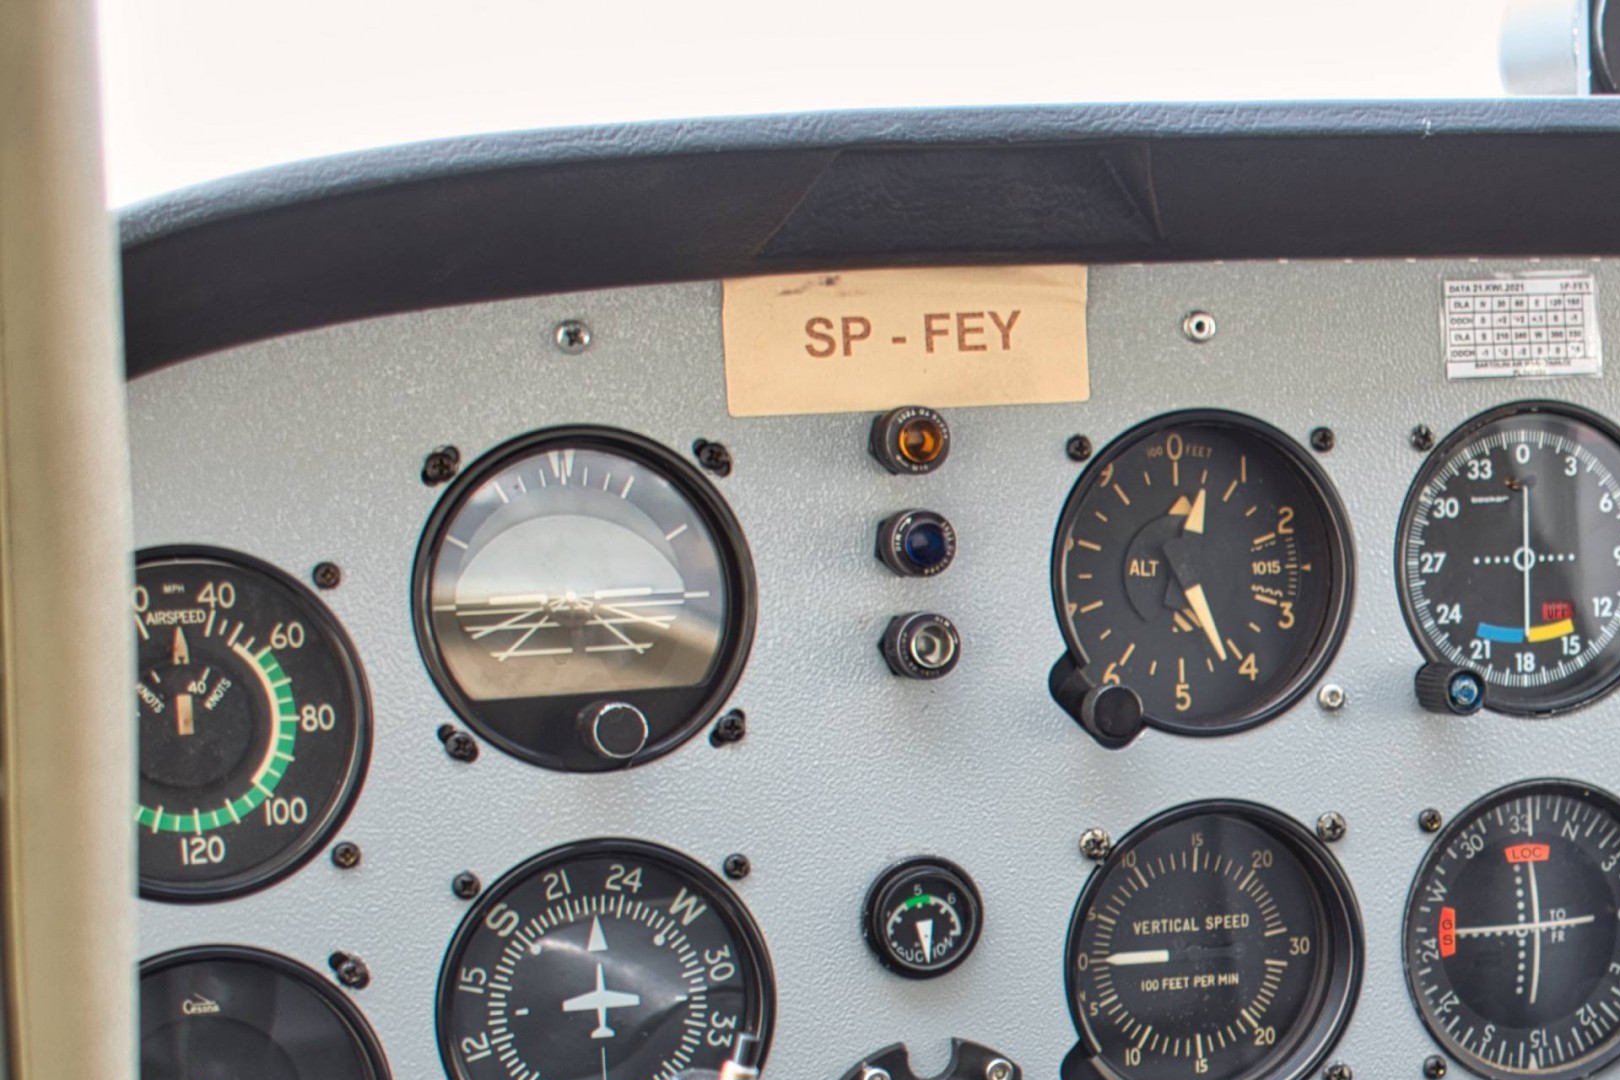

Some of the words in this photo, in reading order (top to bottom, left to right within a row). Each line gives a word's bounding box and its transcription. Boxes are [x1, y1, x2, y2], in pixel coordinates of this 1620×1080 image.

[804, 315, 872, 359] SP
[923, 309, 1021, 355] FEY
[1166, 433, 1184, 460] 0
[1515, 444, 1531, 464] 0
[1466, 458, 1494, 480] 33
[1564, 456, 1578, 476] 3
[1432, 497, 1460, 518] 30
[1277, 506, 1295, 534] 2
[1128, 559, 1160, 578] ALT
[1251, 561, 1281, 575] 1015
[1419, 551, 1447, 574] 27
[162, 583, 185, 594] MPH
[197, 581, 236, 609] 40
[145, 609, 207, 626] AIRSPEED
[1278, 601, 1296, 629] 3
[1436, 603, 1463, 625] 24
[1593, 597, 1613, 617] 12
[270, 621, 305, 650] 60
[1561, 636, 1581, 656] 15
[1470, 639, 1491, 660] 21
[1238, 652, 1259, 681] 4
[1515, 652, 1535, 673] 18
[187, 681, 207, 695] 40
[203, 677, 233, 711] KNOTS
[1175, 683, 1192, 712] 5
[300, 704, 335, 732] 80
[263, 797, 308, 827] 100
[1561, 823, 1580, 841] N
[180, 836, 226, 867] 120
[1460, 834, 1485, 859] 30
[1511, 846, 1542, 860] LOC
[1251, 850, 1273, 868] 20
[542, 868, 572, 901] 21
[604, 863, 643, 893] 24
[667, 886, 707, 927] W
[1549, 908, 1566, 921] TO
[484, 901, 520, 938] S
[1132, 916, 1200, 936] VERTICAL
[1205, 913, 1250, 931] SPEED
[1288, 937, 1310, 956] 30
[1551, 931, 1565, 944] FR
[1421, 938, 1440, 962] 24
[704, 943, 735, 982] 30
[458, 966, 487, 994] 15
[1140, 978, 1160, 992] 100
[1161, 976, 1189, 990] FEET
[1193, 975, 1216, 988] PER
[1217, 973, 1240, 986] MIN
[182, 998, 220, 1015] Cessna
[1438, 989, 1461, 1013] 21
[1575, 1002, 1598, 1026] 12
[707, 1010, 737, 1048] 33
[1253, 1026, 1276, 1046] 20
[1529, 1029, 1549, 1049] 15
[461, 1031, 492, 1063] 12
[1124, 1047, 1141, 1066] 10
[1194, 1058, 1209, 1074] 15
